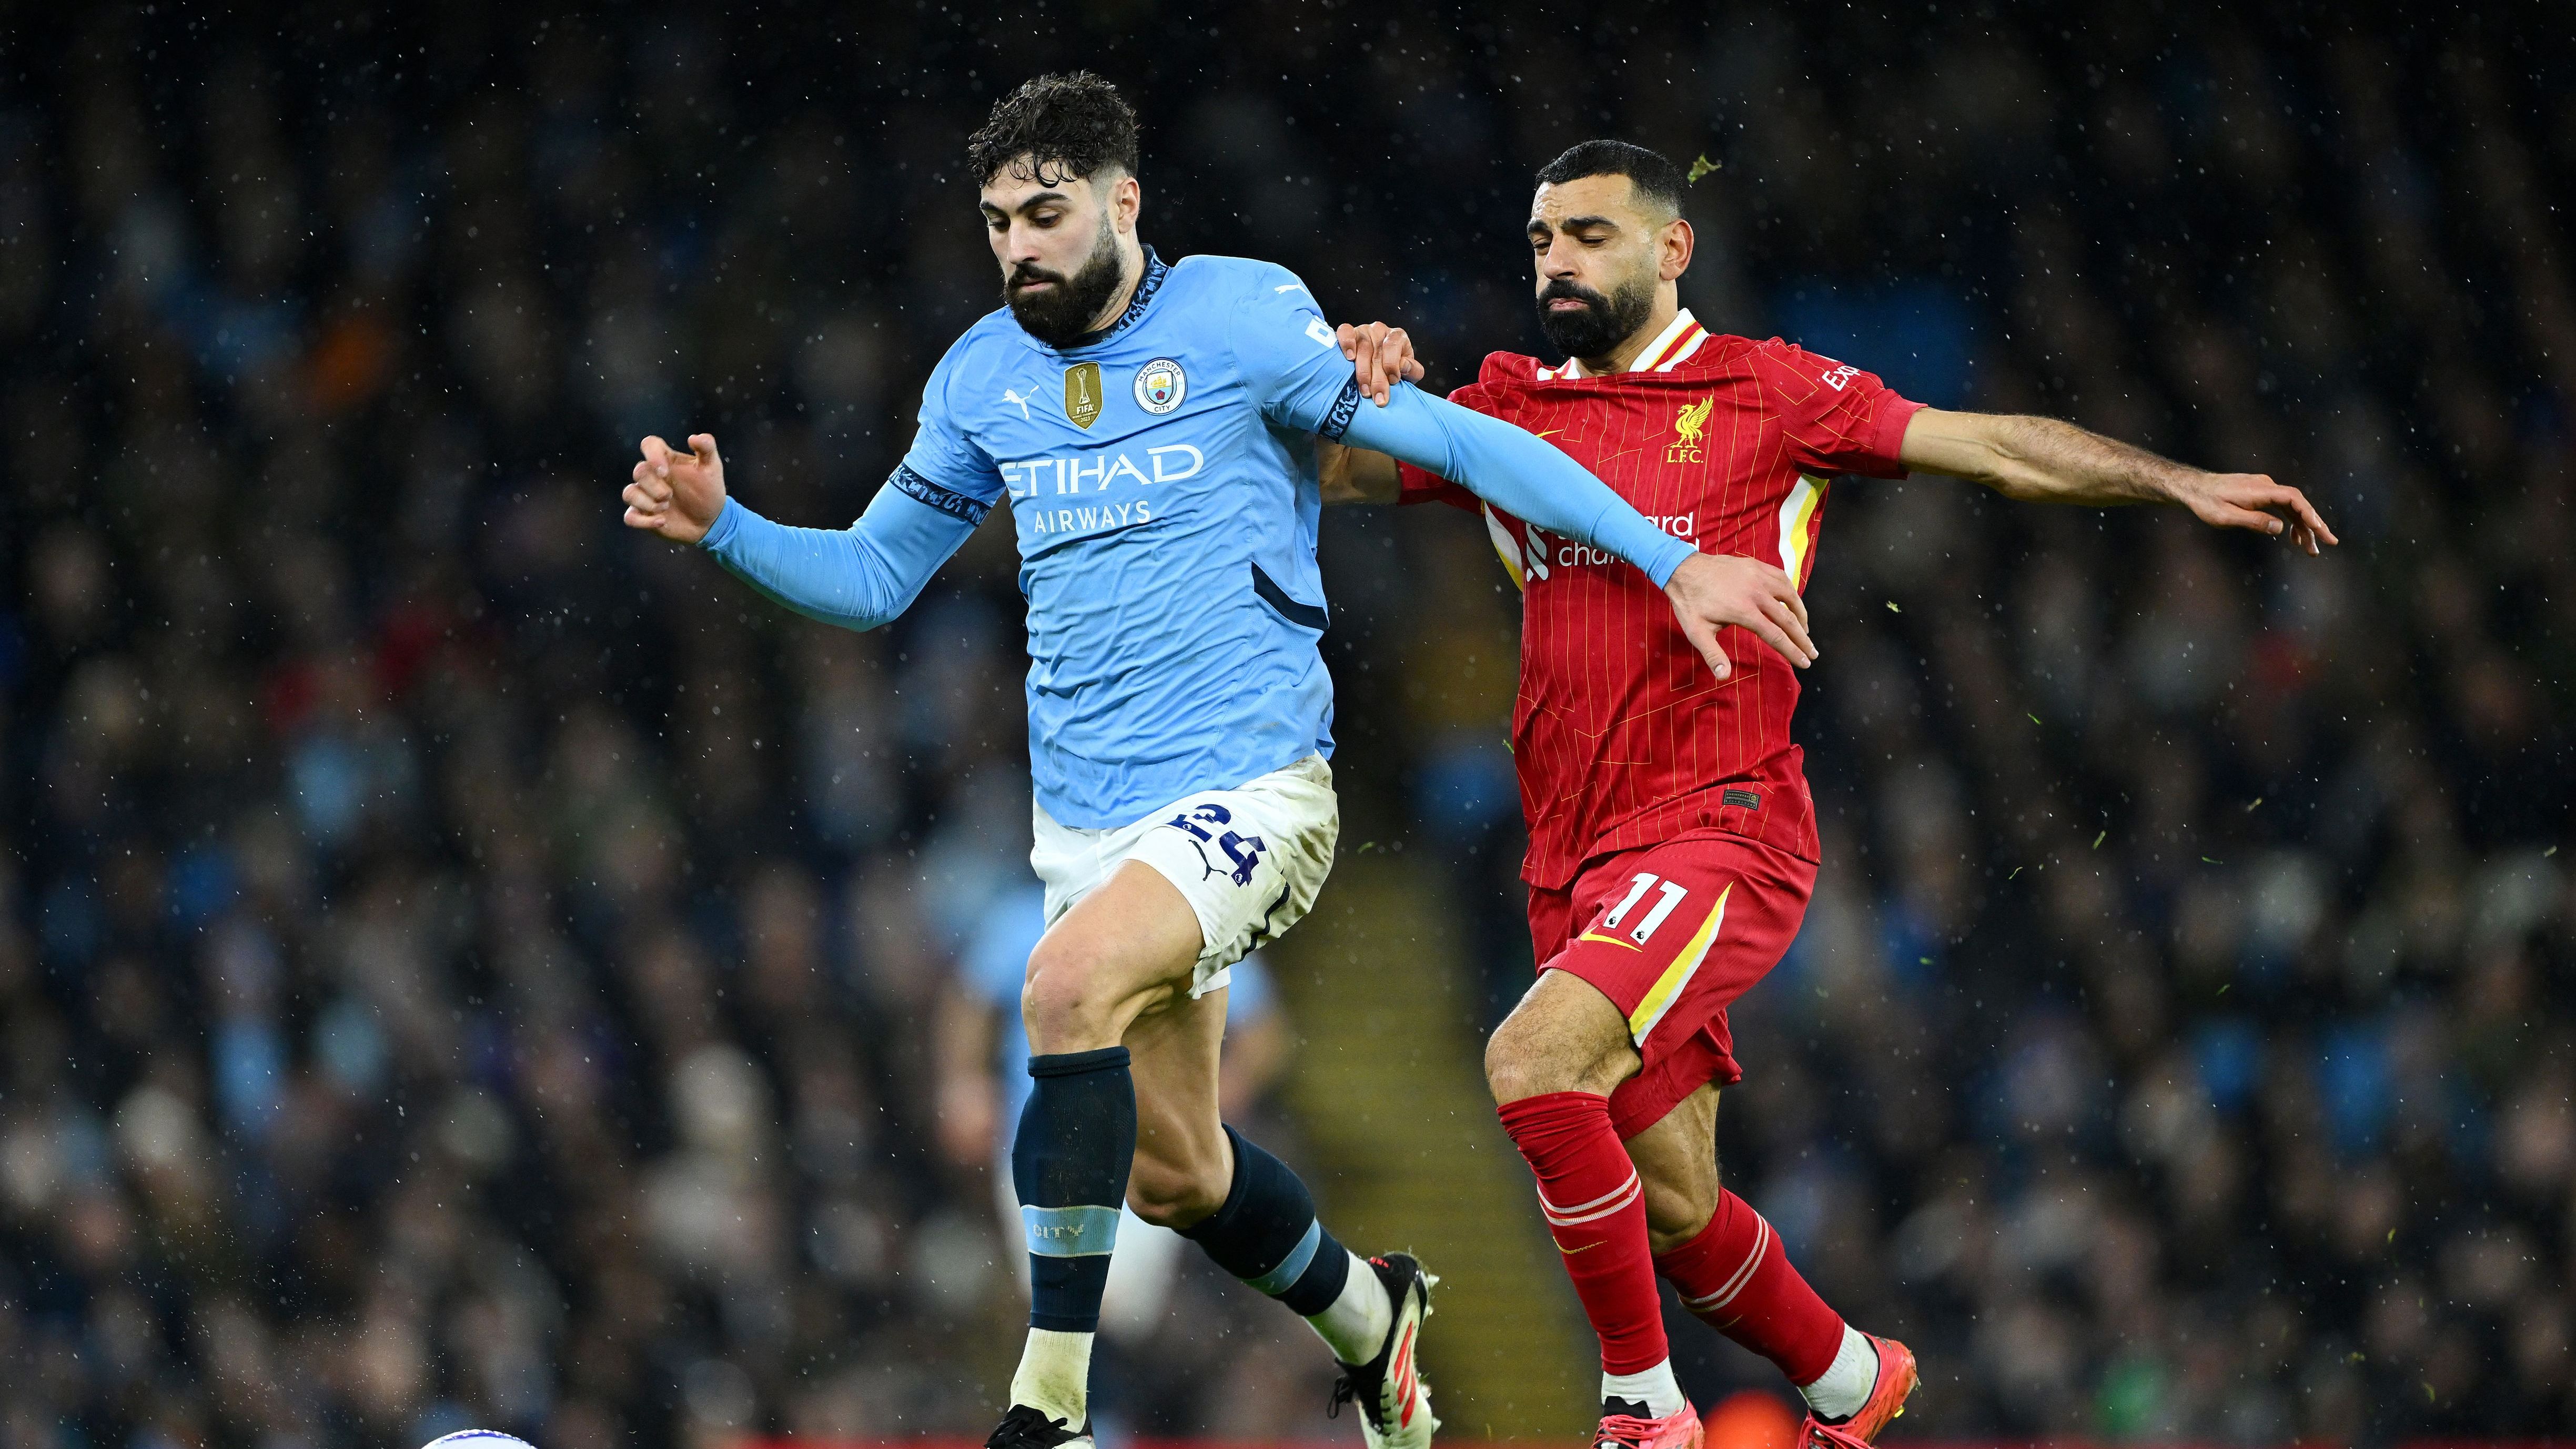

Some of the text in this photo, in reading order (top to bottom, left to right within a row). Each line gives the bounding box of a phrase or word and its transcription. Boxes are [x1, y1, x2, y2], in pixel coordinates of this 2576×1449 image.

[1138, 362, 1180, 382] MANCHESTER
[1076, 404, 1094, 414] FIFA
[998, 444, 1204, 496] ETIHAD
[1034, 500, 1150, 533] AIRWAYS
[1164, 804, 1267, 888] 24
[1603, 872, 1689, 946] 11
[1033, 1223, 1084, 1239] CITY
